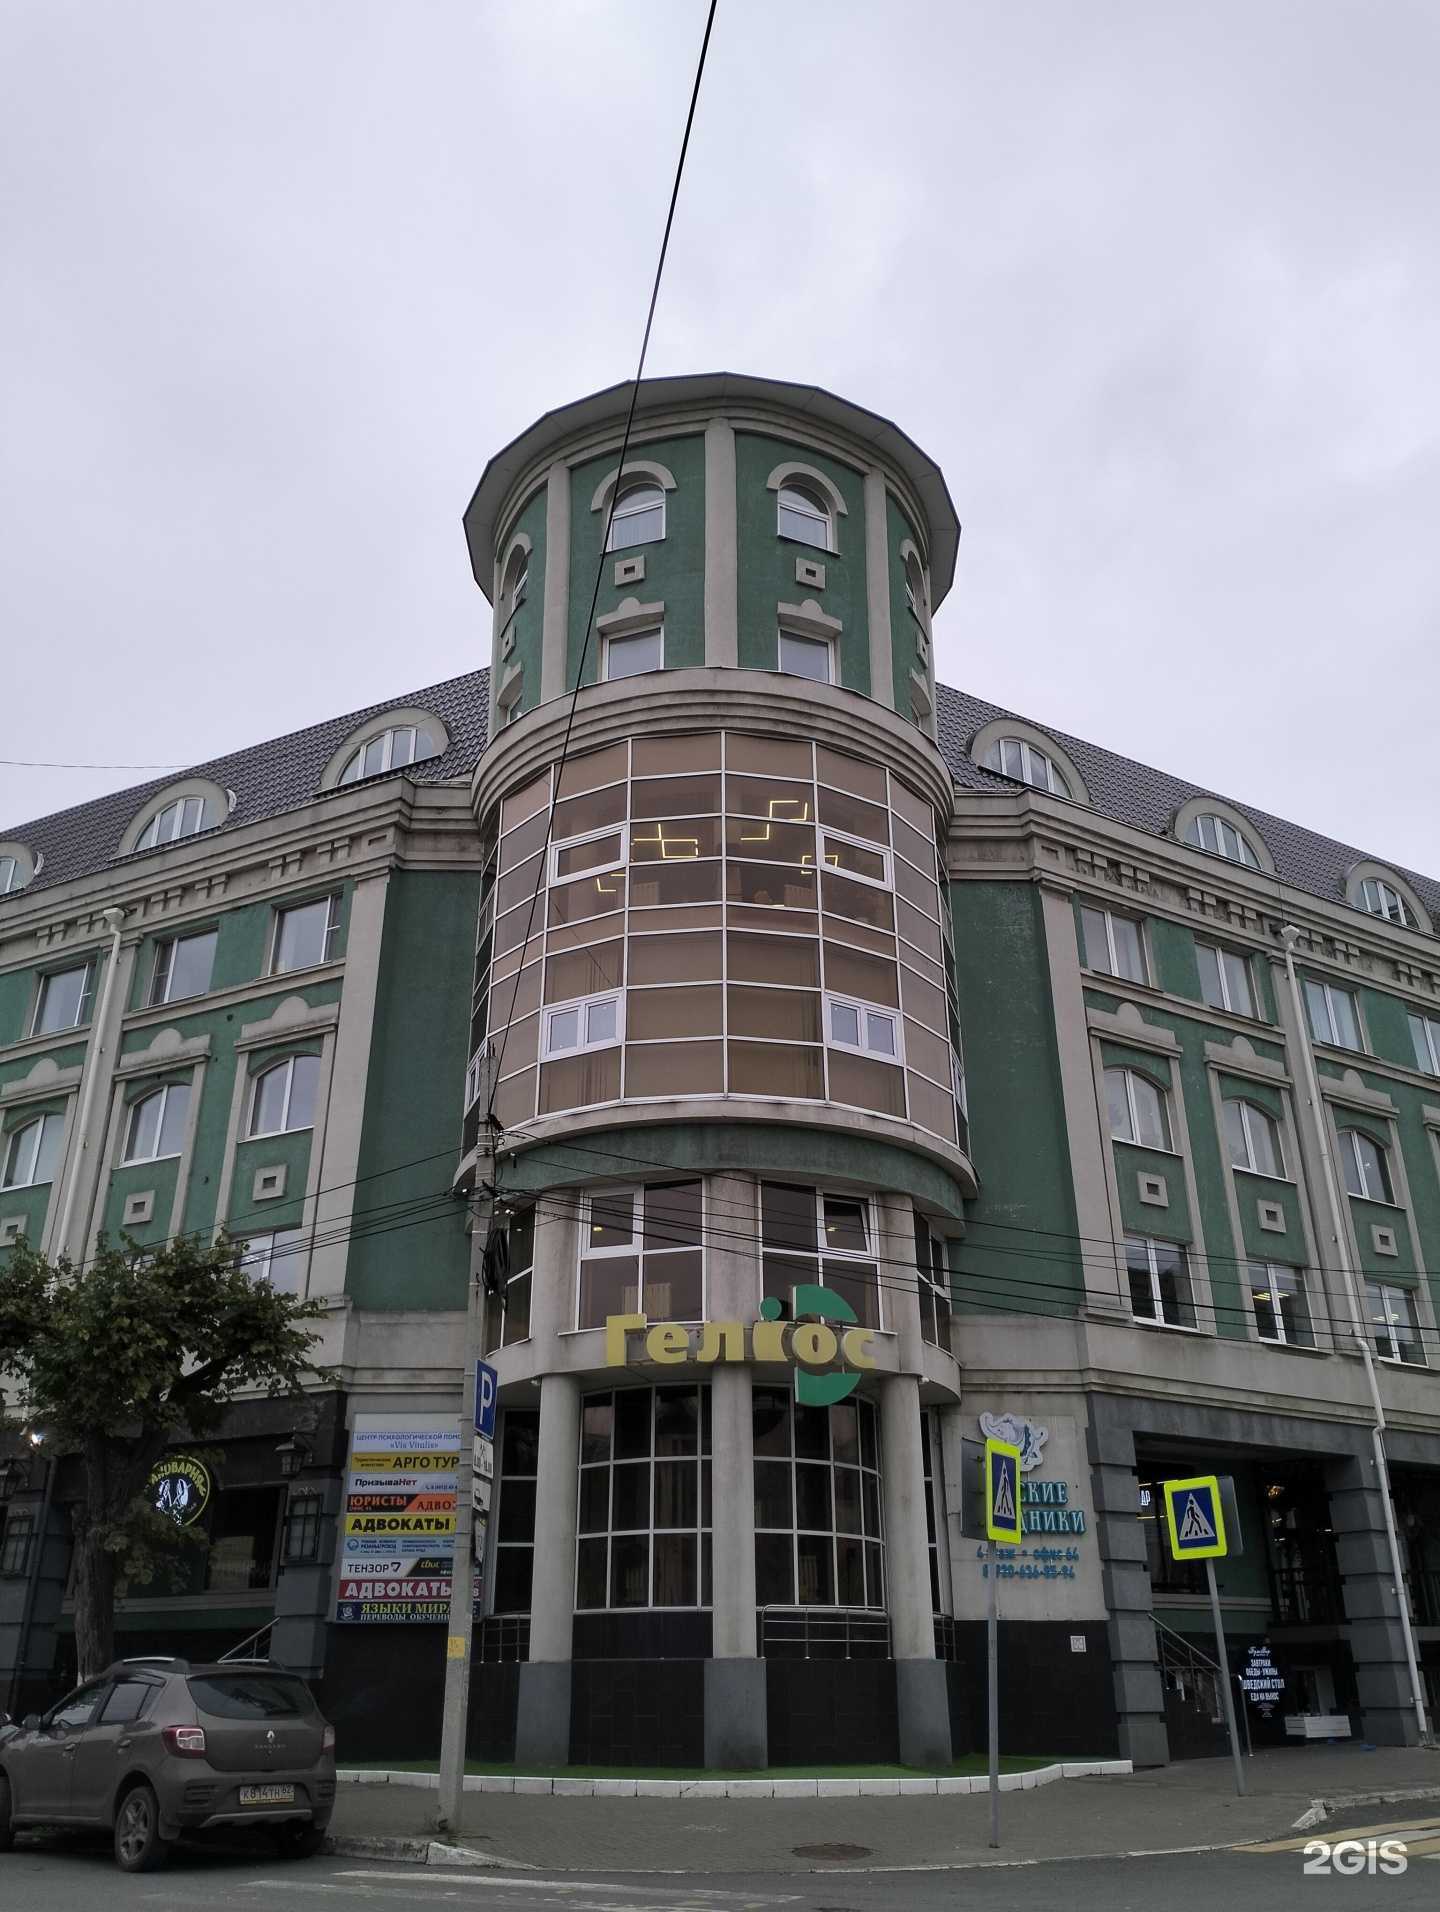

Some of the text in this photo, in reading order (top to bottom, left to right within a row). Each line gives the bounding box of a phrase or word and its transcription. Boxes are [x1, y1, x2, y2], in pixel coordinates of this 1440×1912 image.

[392, 1456, 430, 1469] АРГО
[434, 1456, 460, 1468] ТУР
[350, 1495, 407, 1506] ЮРИСТЫ
[351, 1518, 450, 1532] АДВОКАТЫ
[348, 1563, 389, 1574] ТЕНЗОР
[361, 1603, 412, 1614] ЯЗЫКИ
[360, 1613, 406, 1622] ПЕРЕВОДЫ
